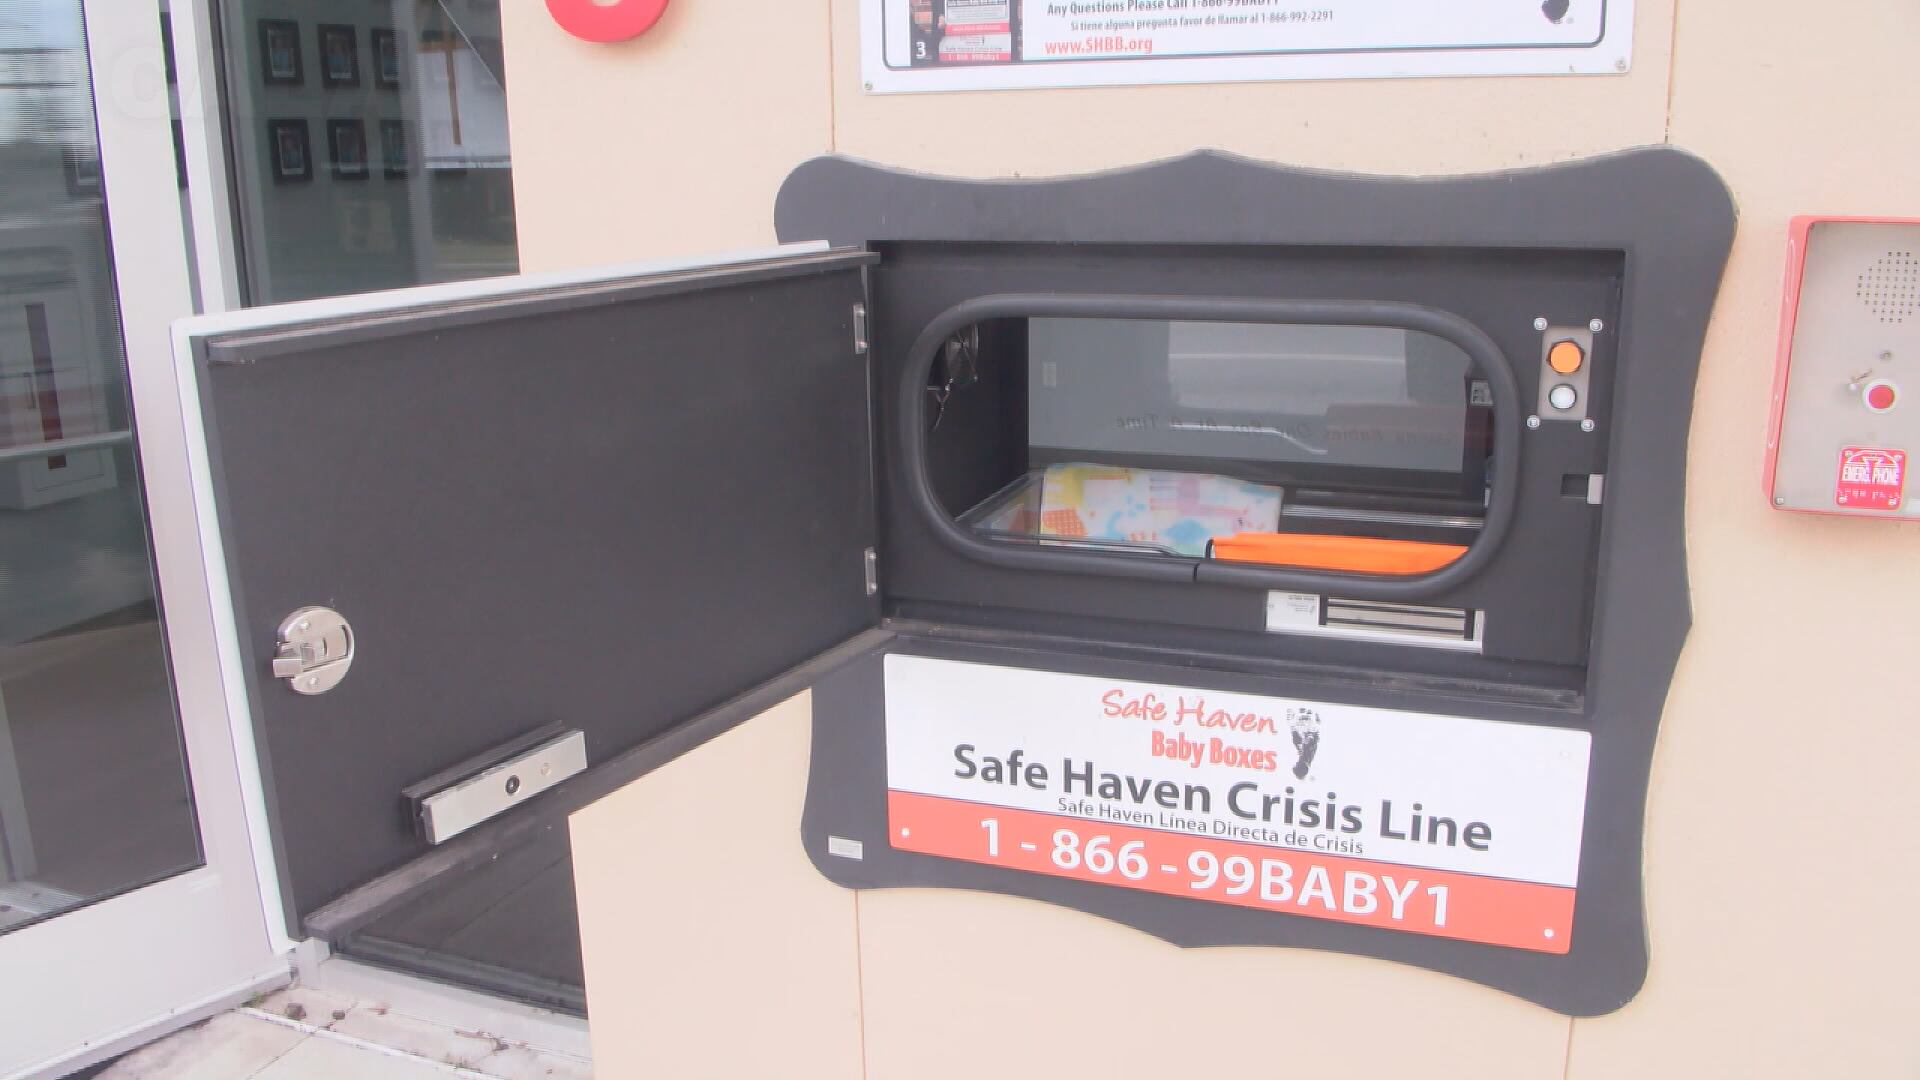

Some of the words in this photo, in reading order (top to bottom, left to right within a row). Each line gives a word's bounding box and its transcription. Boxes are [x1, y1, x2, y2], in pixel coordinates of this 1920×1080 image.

[1047, 3, 1067, 16] Any
[1070, 2, 1124, 14] Questions
[1128, 0, 1165, 11] Please
[1166, 0, 1188, 9] Call
[1080, 20, 1103, 31] tiene
[1104, 18, 1135, 32] alguna
[1137, 17, 1180, 31] pregunta
[1180, 16, 1202, 28] favor
[1204, 15, 1216, 25] de
[1217, 12, 1248, 25] llamar
[1250, 12, 1259, 23] al
[915, 41, 927, 60] 3
[1044, 36, 1153, 54] www.SHBB.org
[1101, 689, 1168, 721] Safe
[1173, 696, 1278, 734] Haven
[1151, 730, 1205, 768] Baby
[1209, 737, 1278, 772] Boxes
[953, 743, 1049, 791] Safe
[1062, 757, 1212, 815] Haven
[1226, 780, 1364, 835] Crisis
[1379, 798, 1493, 851] Line
[1057, 797, 1094, 817] Safe
[1098, 803, 1154, 826] Haven
[1212, 820, 1280, 844] Directa
[1284, 829, 1309, 847] de
[1313, 833, 1364, 855] Crisis
[979, 816, 1000, 858] 1
[1050, 827, 1150, 881] 866
[1186, 850, 1450, 928] 99BABY1
